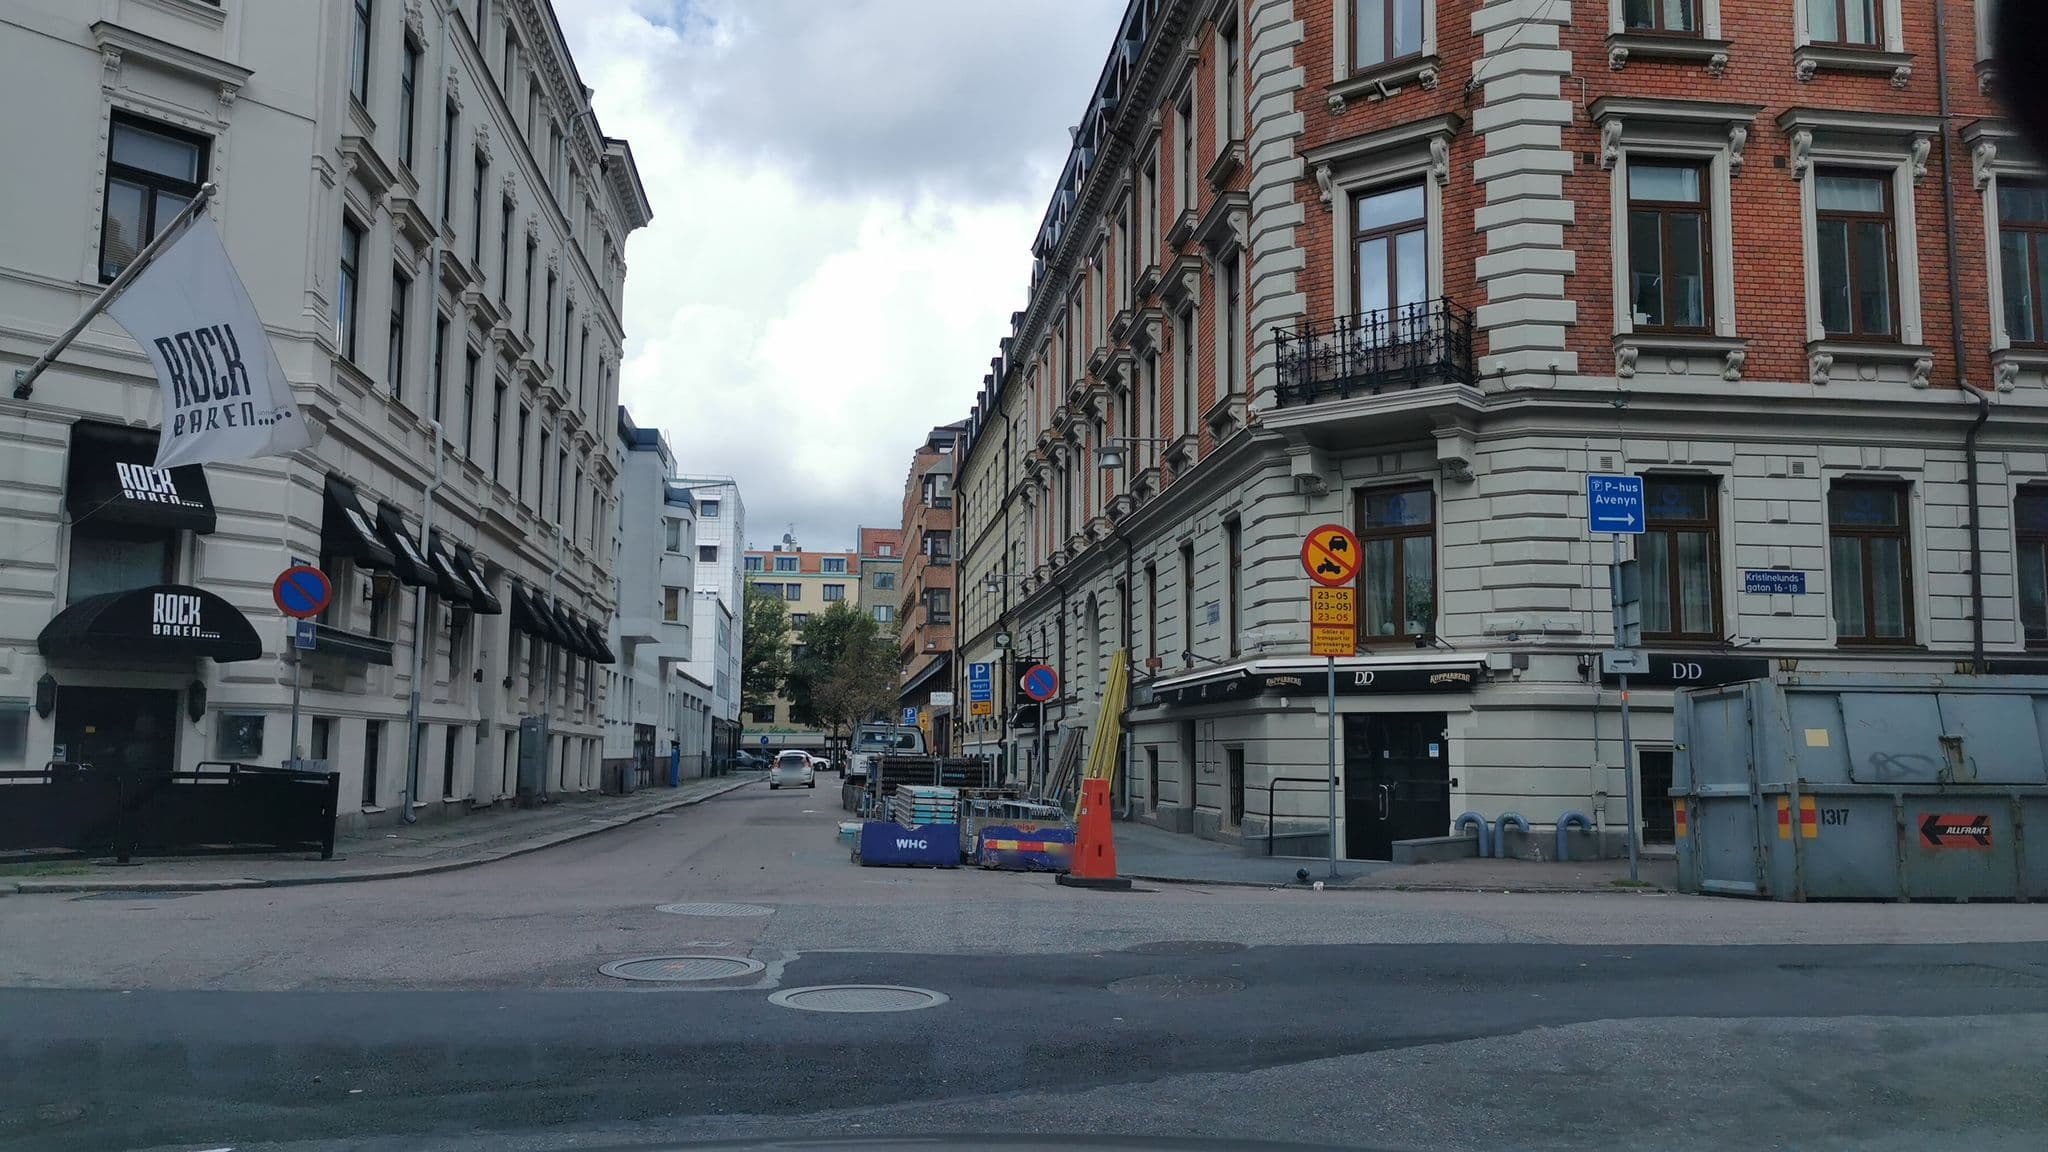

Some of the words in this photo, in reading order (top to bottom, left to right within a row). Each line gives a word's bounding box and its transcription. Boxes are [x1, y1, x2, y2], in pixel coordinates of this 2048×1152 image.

[153, 323, 251, 409] ROCK
[116, 462, 177, 495] ROCK
[1605, 481, 1638, 493] P-hus
[1595, 494, 1637, 507] Avenyn
[1746, 573, 1804, 583] Kristinelunds-
[1746, 584, 1771, 593] gatan
[1318, 591, 1348, 600] 23-05
[153, 593, 201, 626] ROCK
[1314, 602, 1351, 611] (23-05)
[1318, 613, 1348, 621] 23-05
[975, 664, 985, 679] P
[1672, 662, 1702, 680] DD
[1354, 671, 1375, 684] DD
[1820, 808, 1850, 826] 1317
[1946, 826, 1989, 835] ALLFRAKT
[896, 838, 928, 850] WHC
